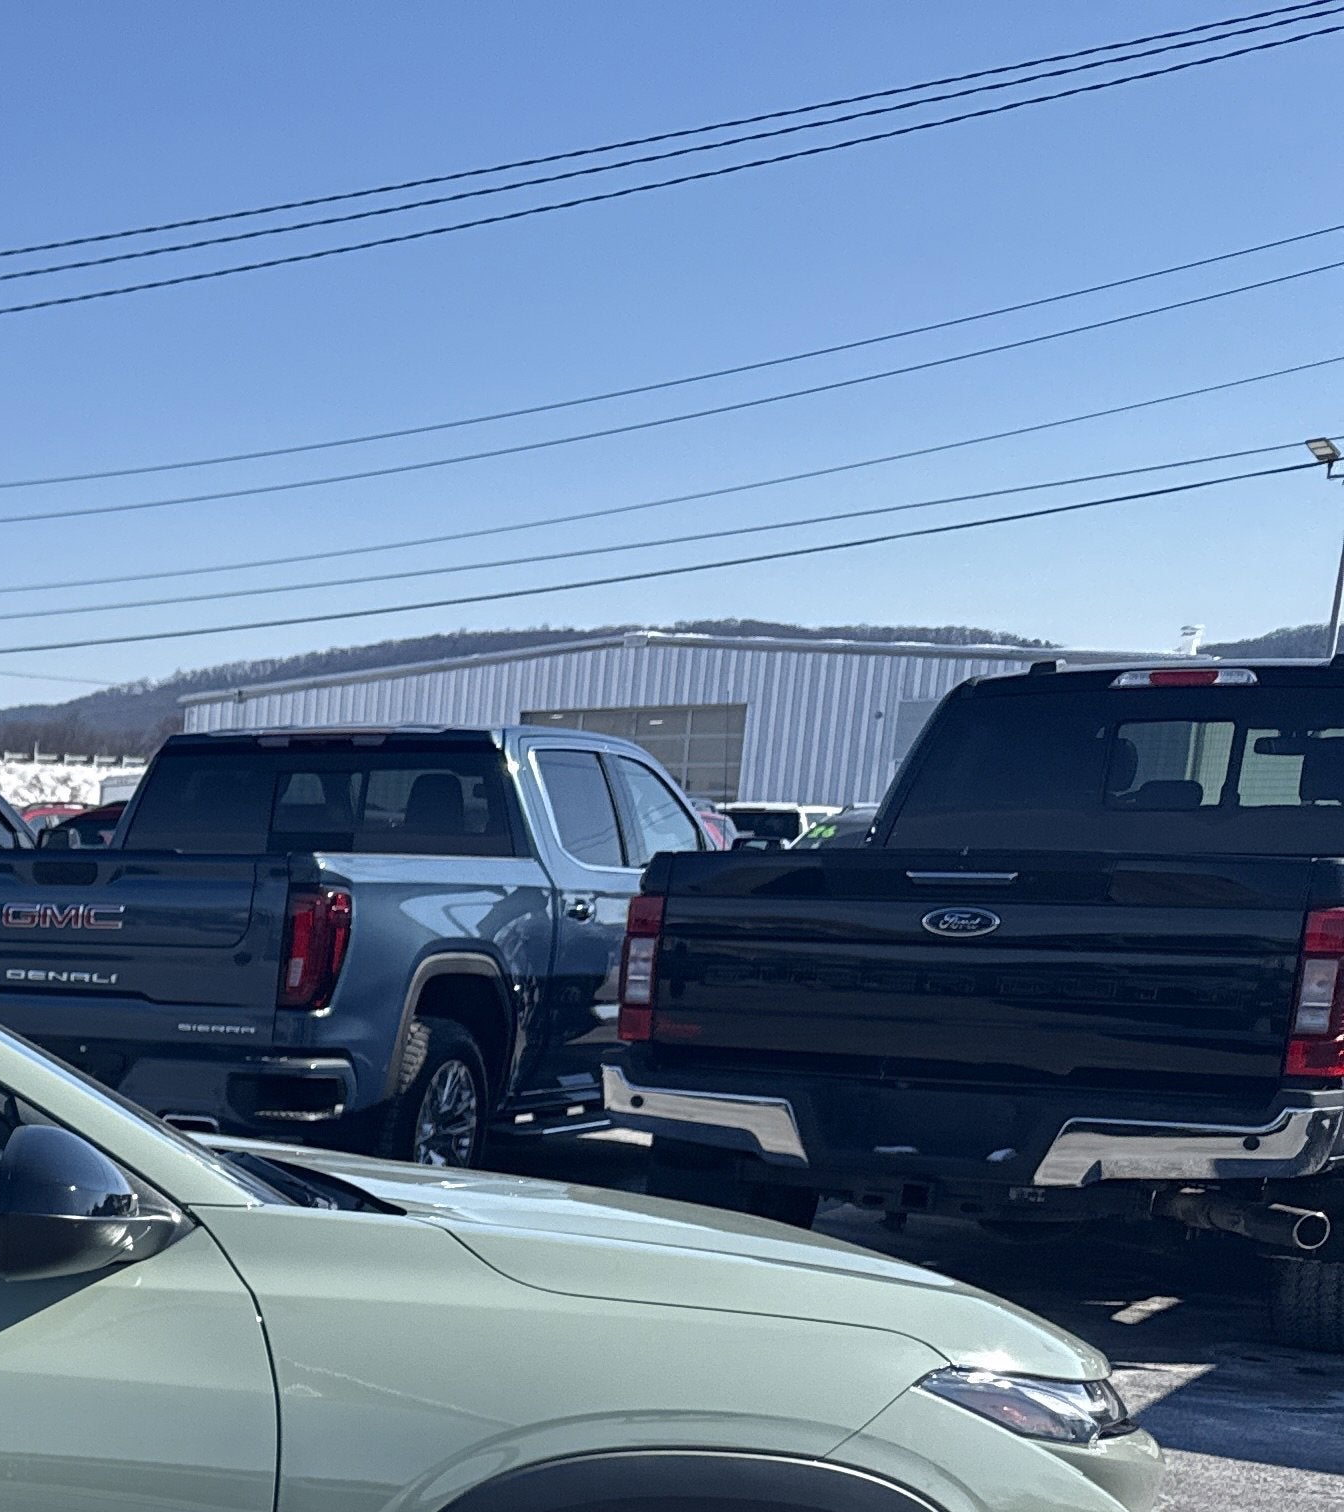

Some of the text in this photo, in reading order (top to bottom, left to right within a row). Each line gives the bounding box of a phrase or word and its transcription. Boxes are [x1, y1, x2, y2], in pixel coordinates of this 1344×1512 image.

[2, 903, 125, 929] GMC
[5, 969, 119, 984] DENALI
[177, 1022, 255, 1034] SIERRA
